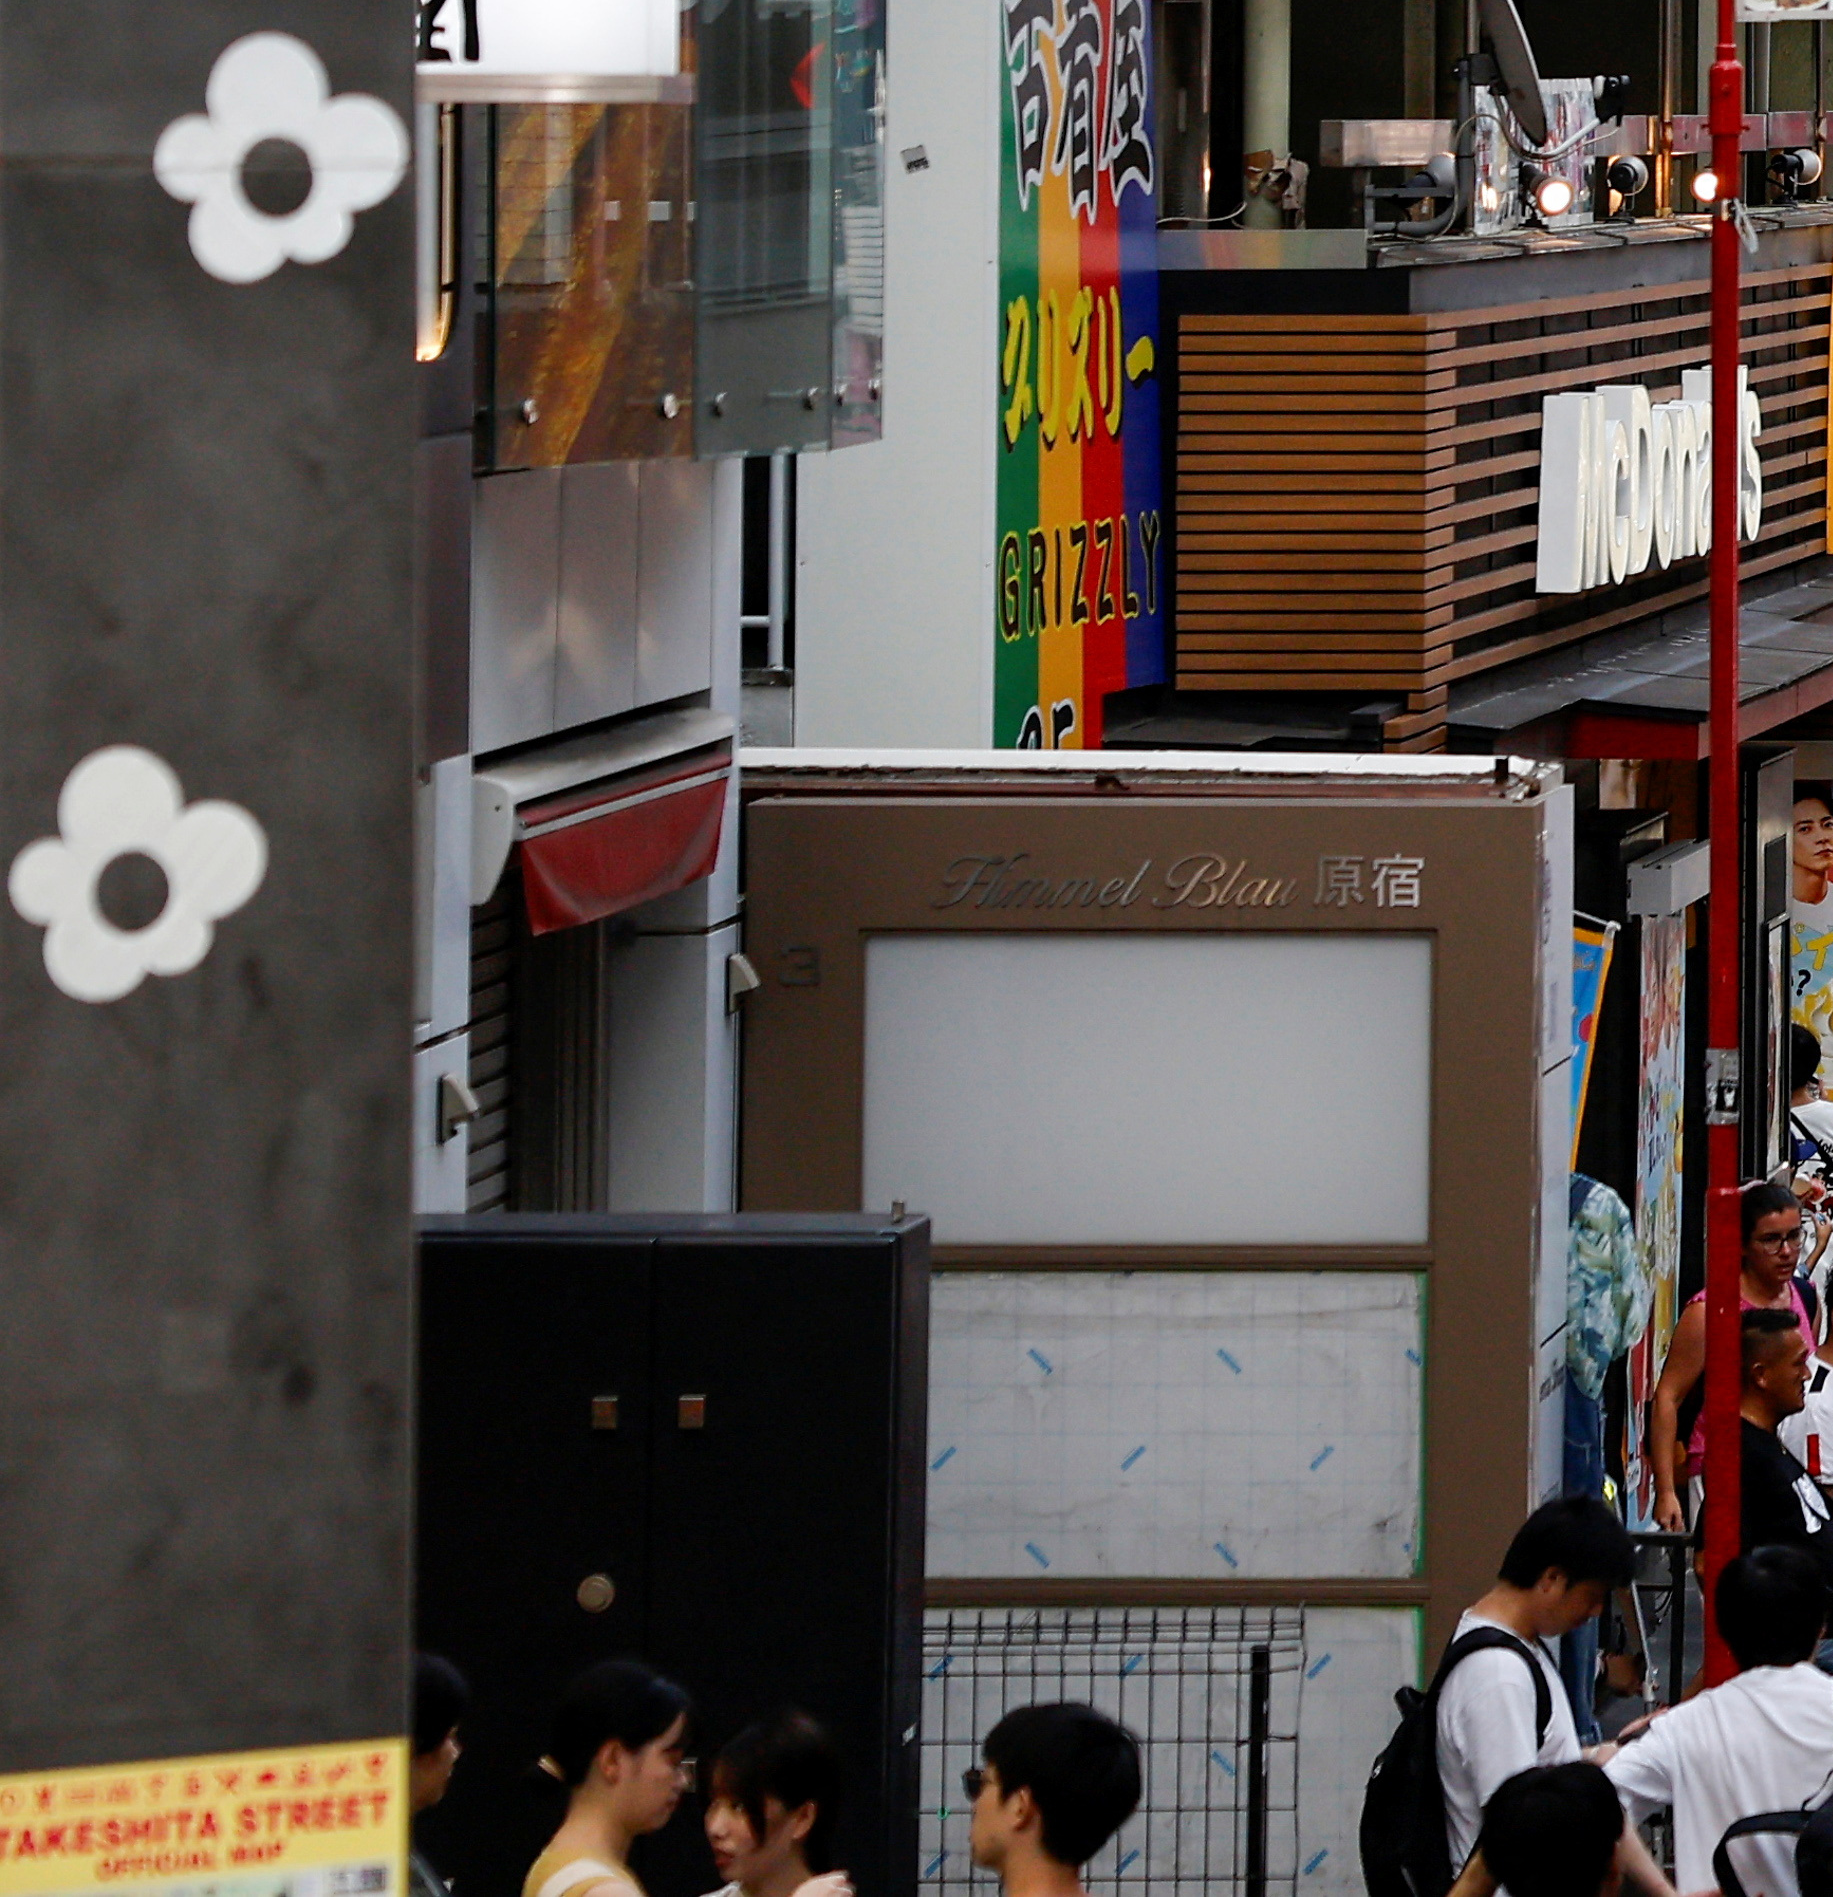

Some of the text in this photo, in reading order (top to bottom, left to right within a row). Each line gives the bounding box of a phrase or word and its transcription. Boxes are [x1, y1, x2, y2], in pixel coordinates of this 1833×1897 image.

[1001, 510, 1160, 643] GRIZZLY
[936, 852, 1426, 911] Himmel Blau 原宿
[237, 1792, 388, 1833] STREET
